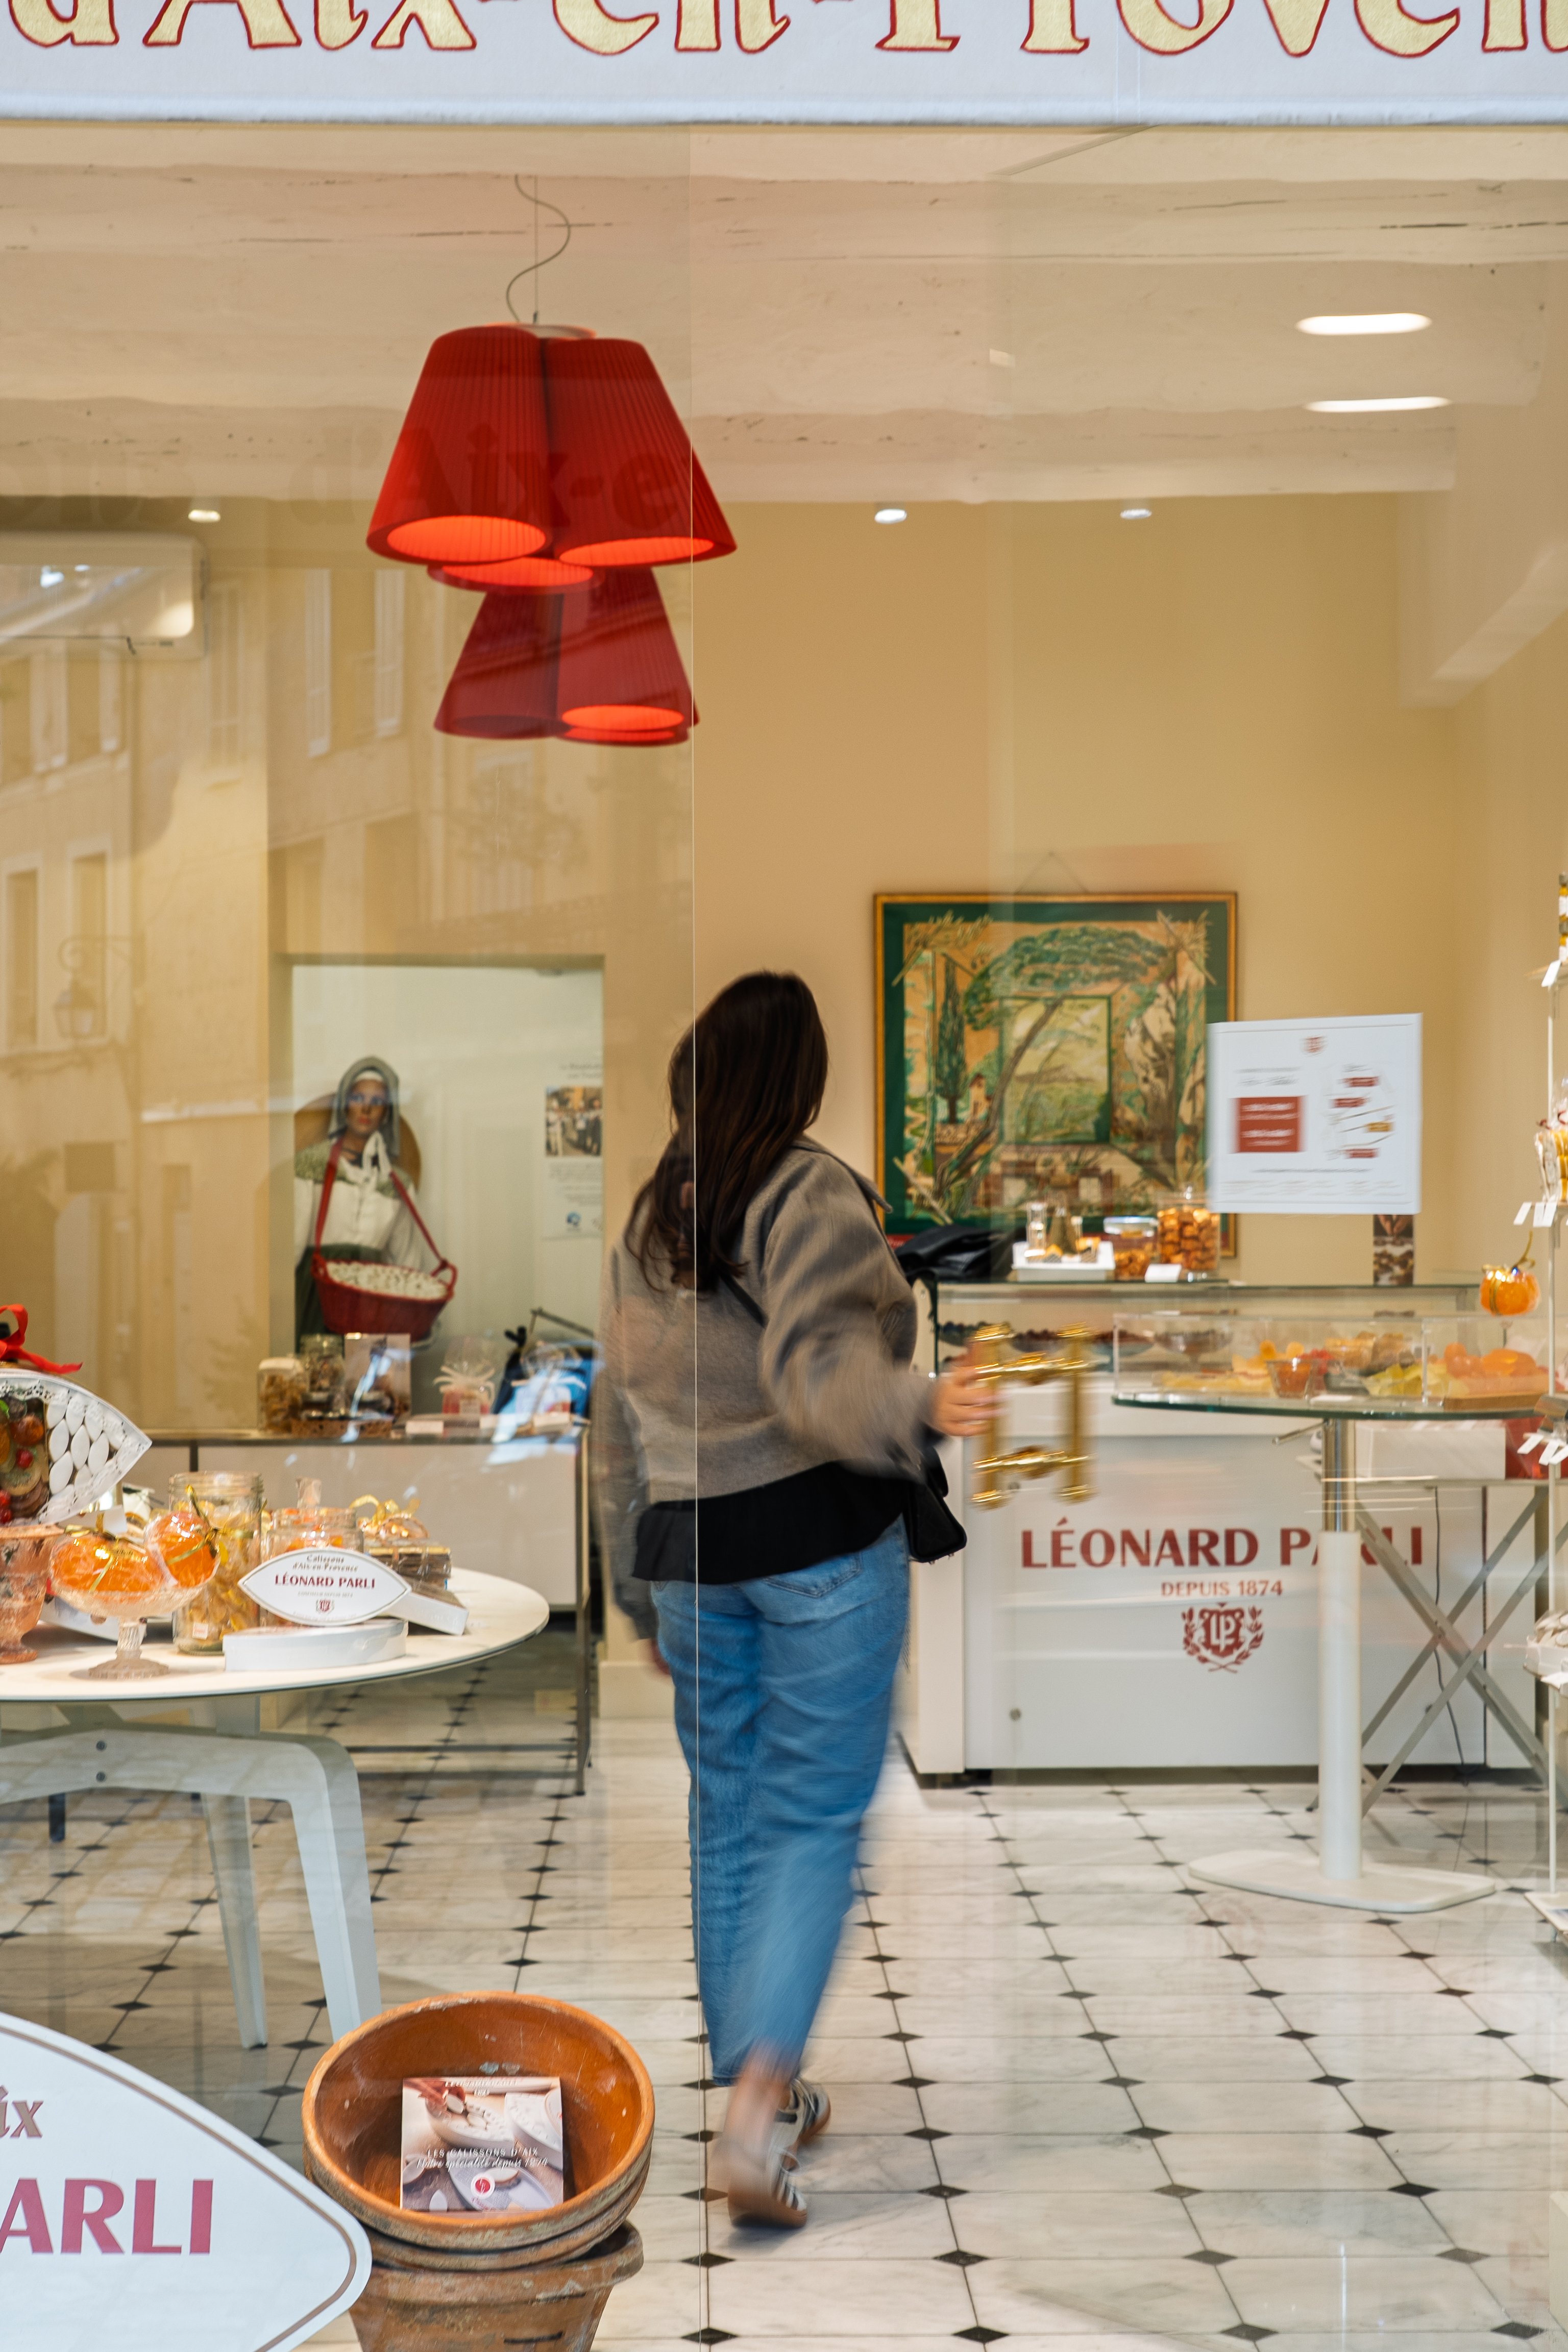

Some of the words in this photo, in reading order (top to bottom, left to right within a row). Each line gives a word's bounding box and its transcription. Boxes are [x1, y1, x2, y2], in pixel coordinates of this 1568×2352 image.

[1021, 1516, 1259, 1569] LÉONARD
[307, 1554, 344, 1563] Calissons
[275, 1572, 334, 1587] LÉONARD
[339, 1577, 376, 1589] PARLI
[1161, 1581, 1230, 1597] DEPUIS
[1238, 1580, 1284, 1597] 1874
[427, 2147, 445, 2159] LES
[450, 2147, 506, 2158] CALISSONS
[511, 2146, 538, 2157] D'AIX
[416, 2157, 444, 2169] Notre
[492, 2155, 522, 2172] depuis
[525, 2156, 549, 2167] 1874
[0, 2178, 214, 2256] ARLI
